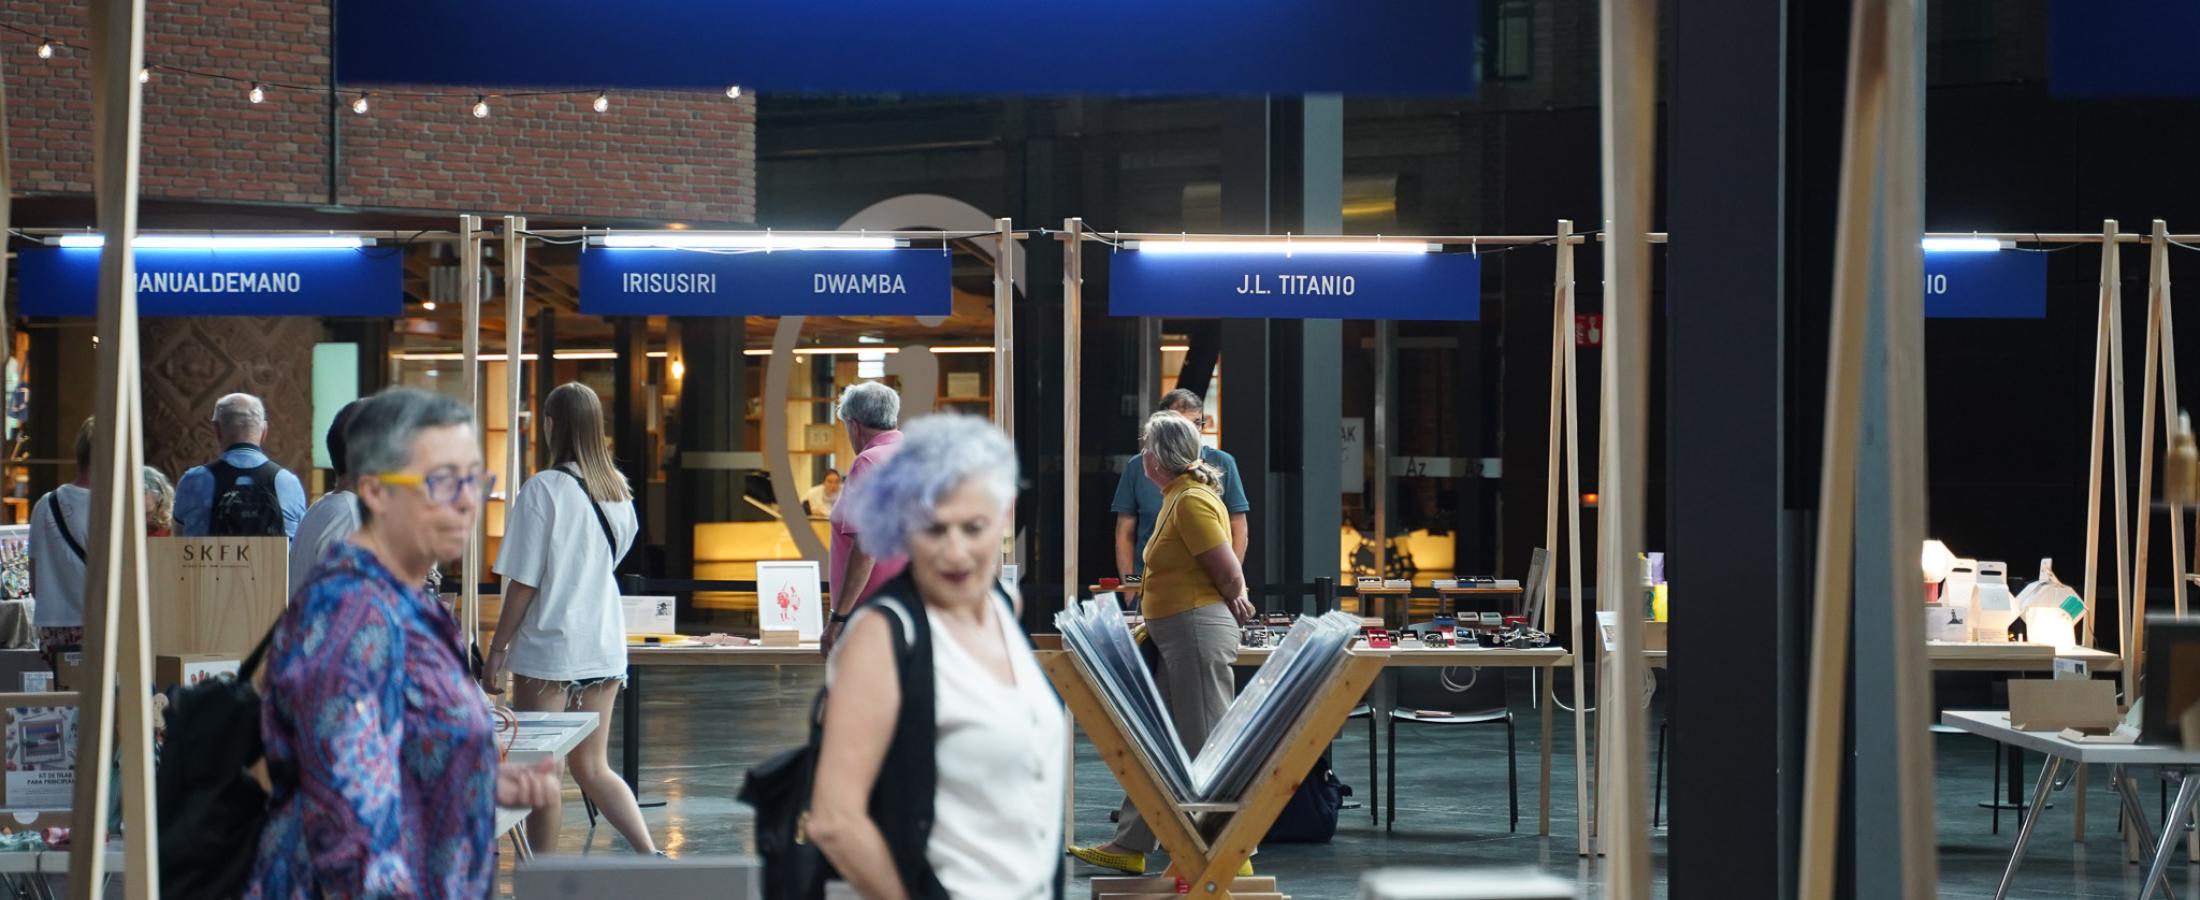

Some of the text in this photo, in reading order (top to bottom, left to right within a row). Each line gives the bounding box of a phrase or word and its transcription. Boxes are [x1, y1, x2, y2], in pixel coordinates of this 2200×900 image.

[623, 272, 717, 293] IRISUSIRI
[813, 273, 907, 294] DWAMBA
[1236, 274, 1356, 296] J.L. TITANIO
[1924, 274, 1948, 294] IO
[183, 544, 250, 561] SKFK
